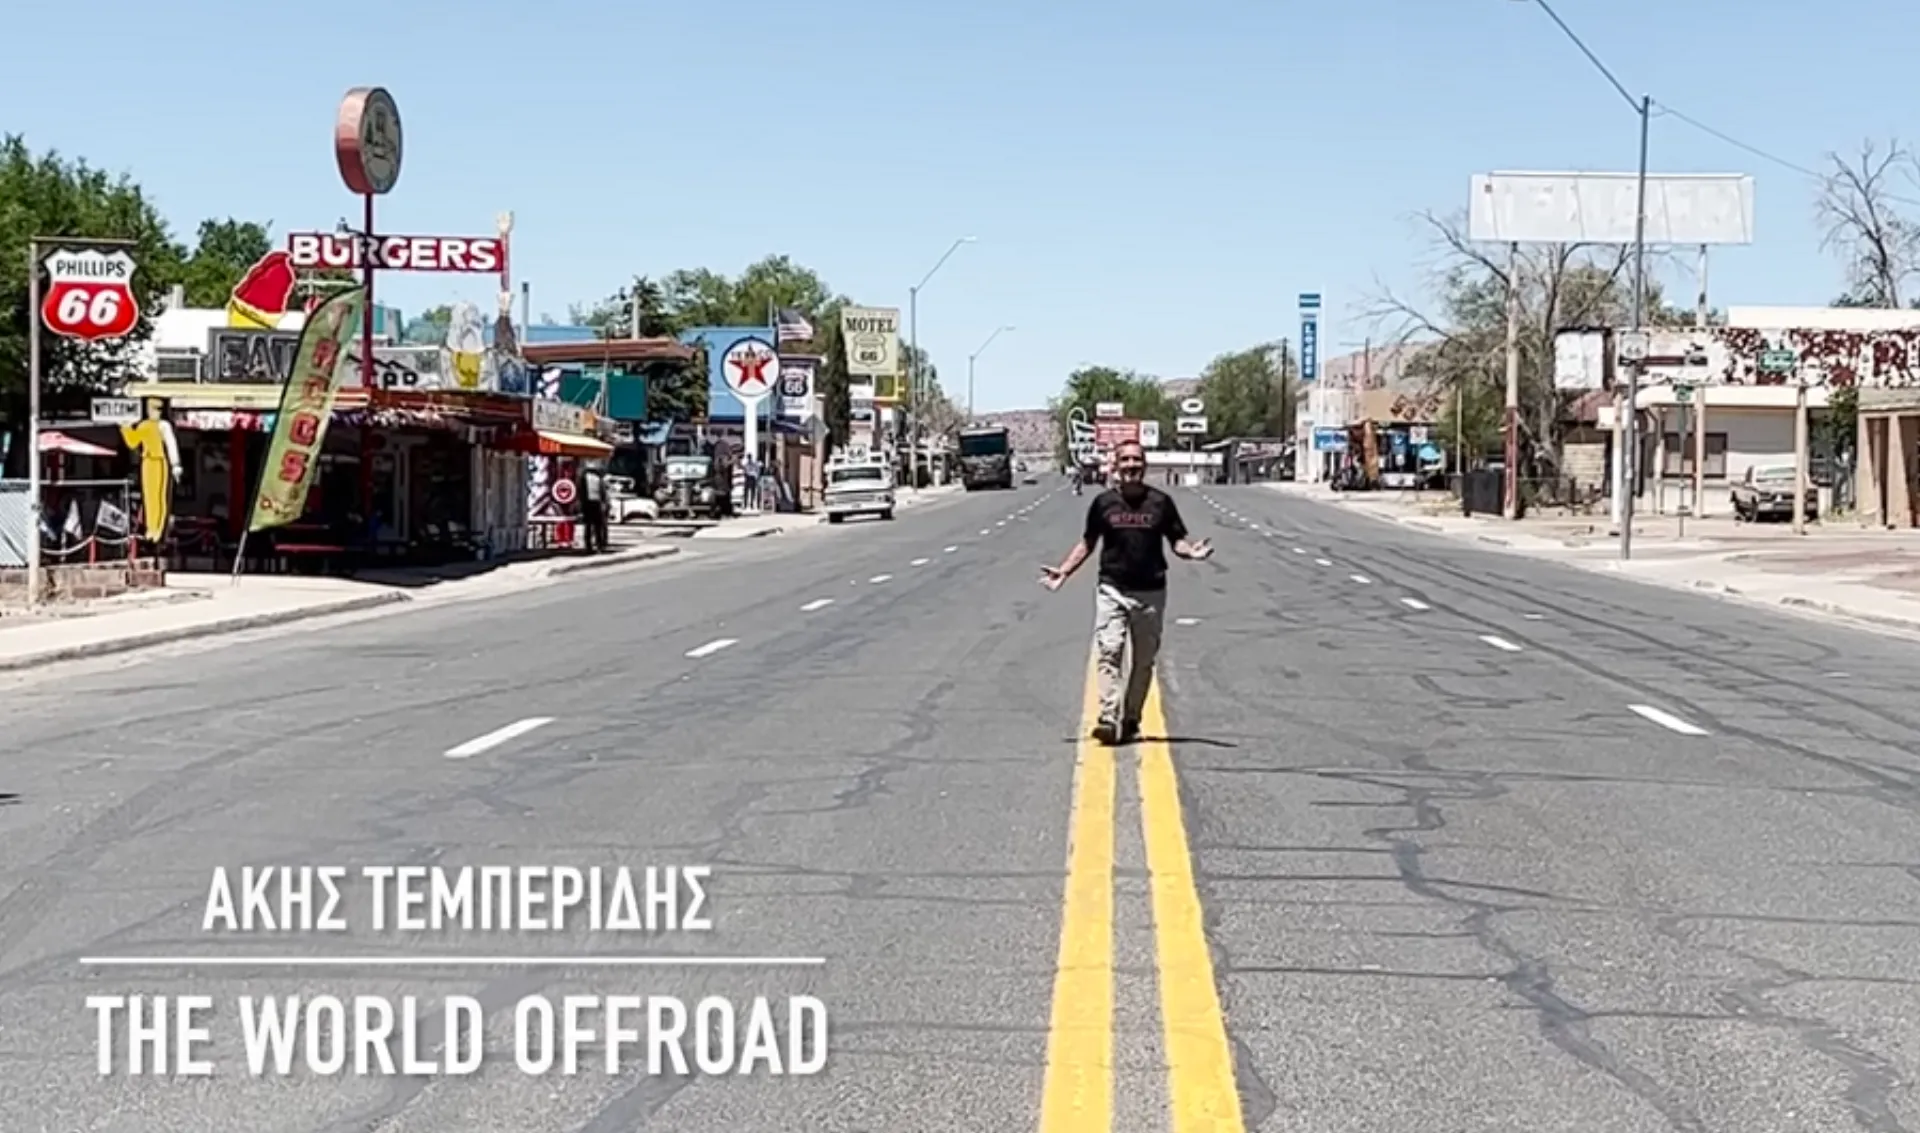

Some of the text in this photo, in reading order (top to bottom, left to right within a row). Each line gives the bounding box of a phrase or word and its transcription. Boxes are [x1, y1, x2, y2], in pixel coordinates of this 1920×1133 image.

[292, 236, 497, 269] BURGERS
[56, 260, 126, 277] PHILLIPS
[58, 288, 120, 326] 66
[845, 317, 896, 333] MOTEL
[860, 351, 878, 362] 66
[784, 378, 804, 394] 66
